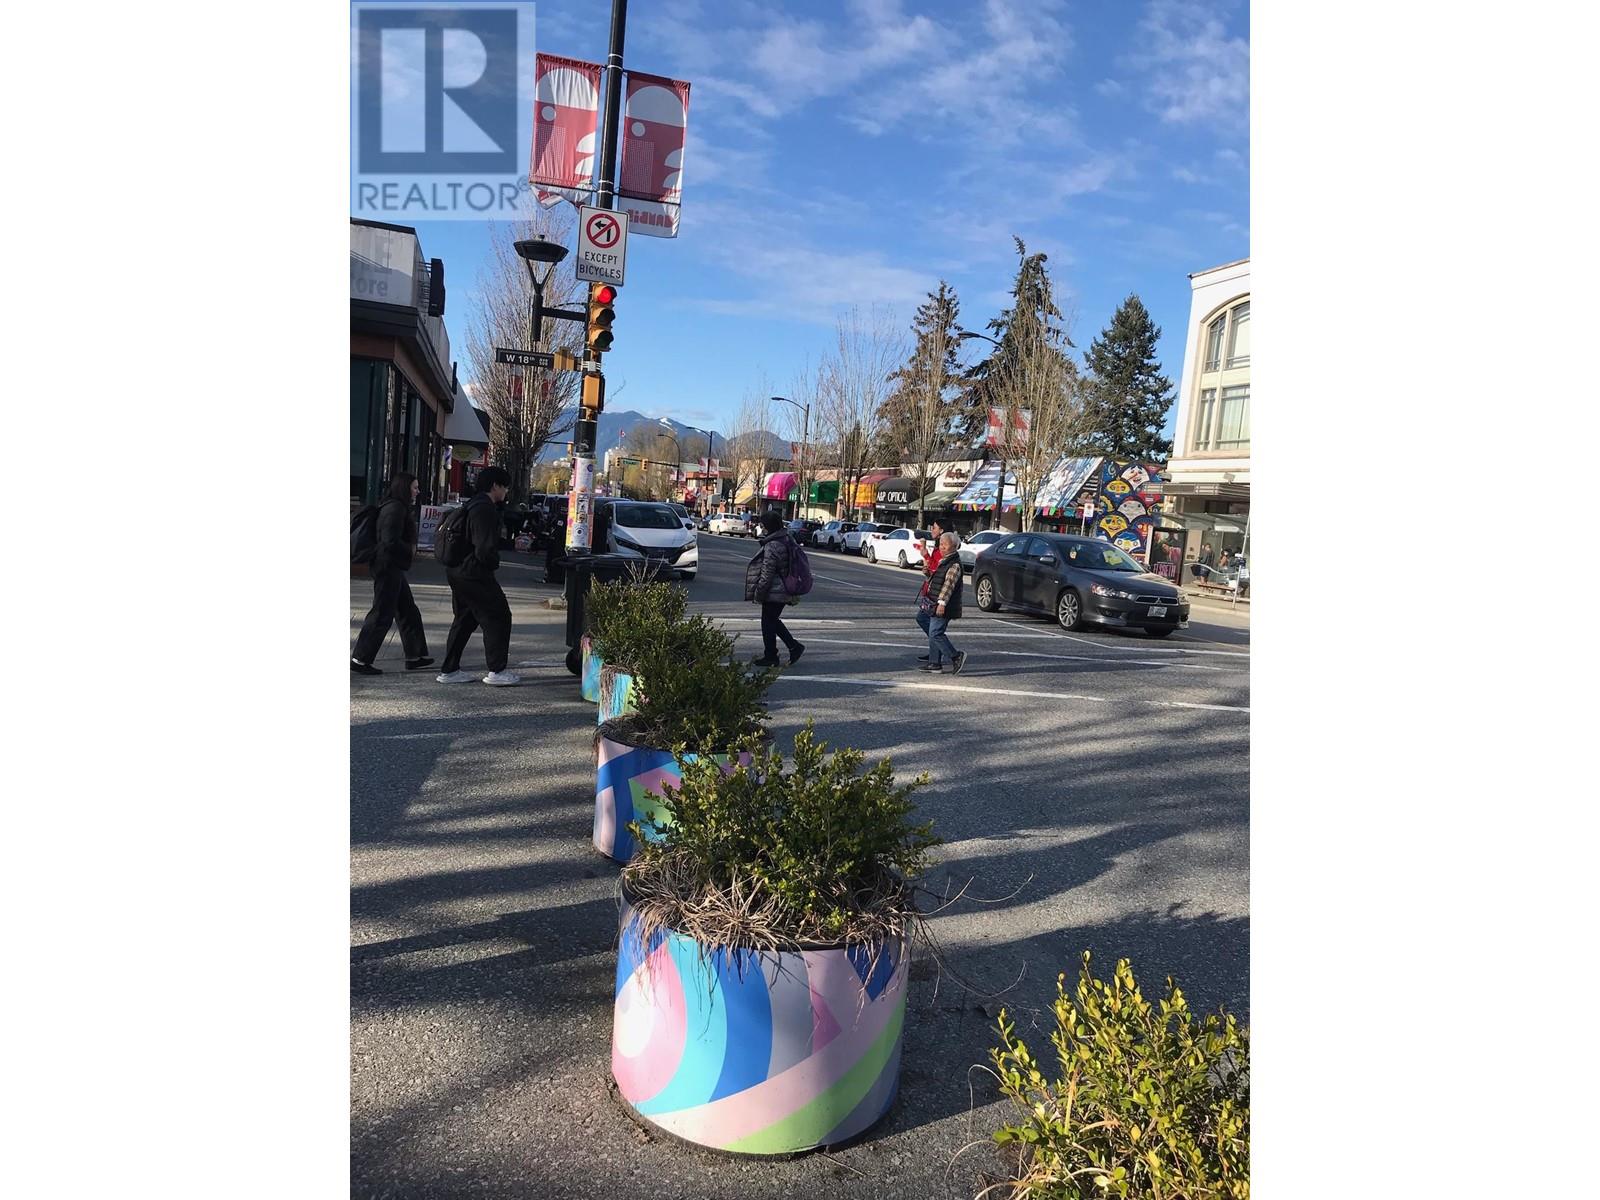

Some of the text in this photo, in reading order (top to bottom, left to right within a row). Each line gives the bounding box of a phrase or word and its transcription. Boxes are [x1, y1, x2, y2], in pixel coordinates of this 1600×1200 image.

[584, 250, 618, 266] EXCEPT
[579, 263, 622, 280] BICYCLES
[505, 354, 516, 363] W
[518, 355, 536, 365] 18th
[887, 490, 908, 503] OPTICAL
